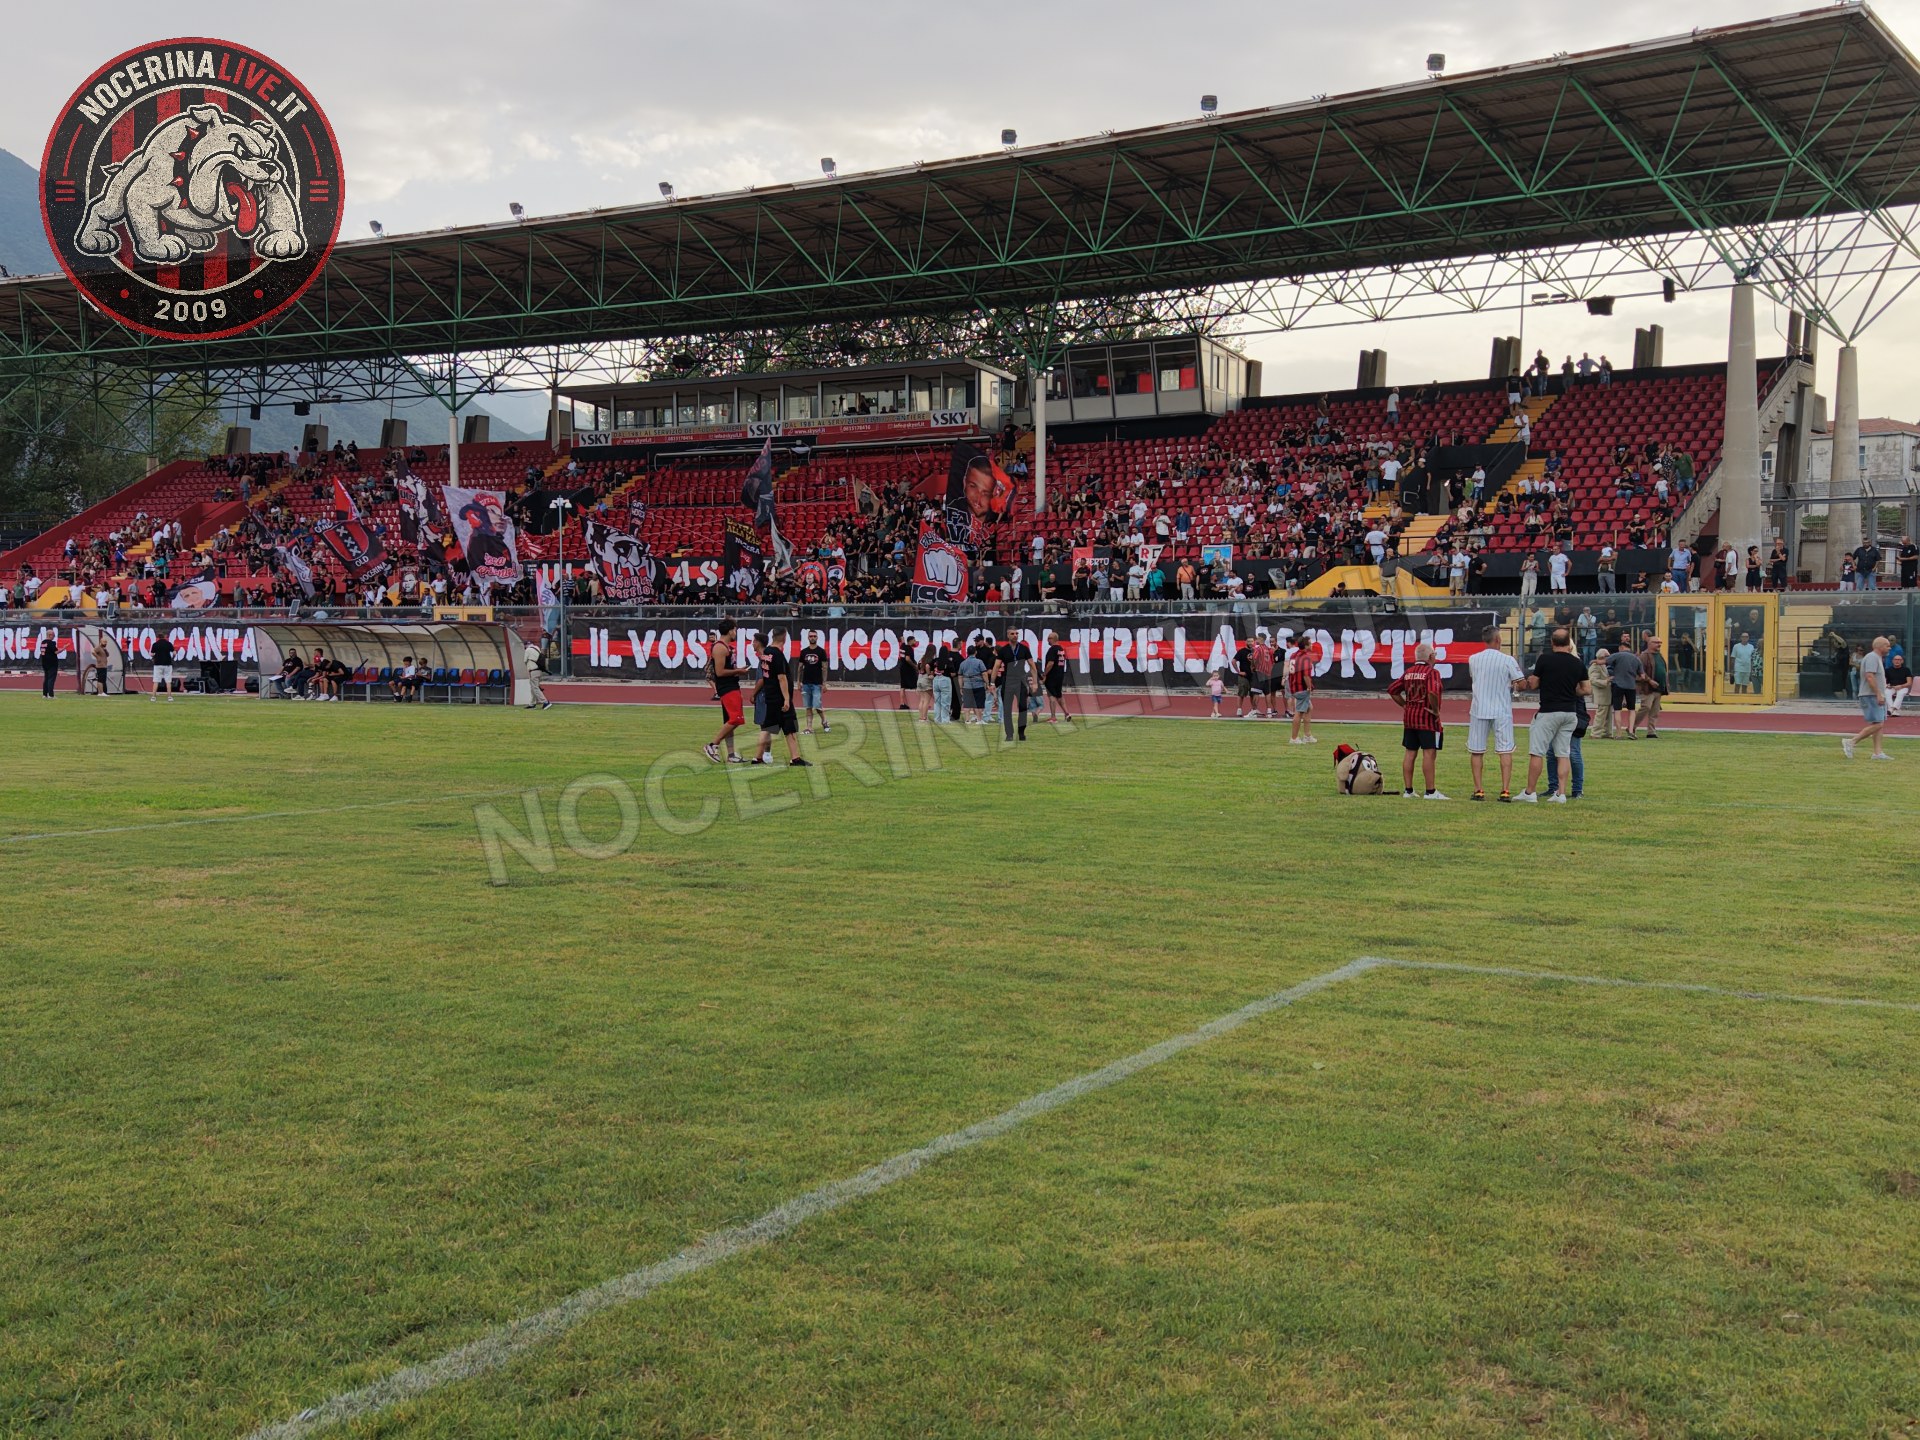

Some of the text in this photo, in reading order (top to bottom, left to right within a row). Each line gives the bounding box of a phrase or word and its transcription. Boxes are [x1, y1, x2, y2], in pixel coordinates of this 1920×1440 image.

[939, 411, 969, 426] SKY
[755, 423, 781, 437] SKY
[587, 433, 611, 446] SKY
[355, 555, 370, 568] OLD
[168, 625, 258, 663] CANTA
[589, 626, 622, 668] IL
[627, 628, 791, 669] VOSRO
[1008, 626, 1163, 674] LTRE
[1173, 625, 1240, 674] LA
